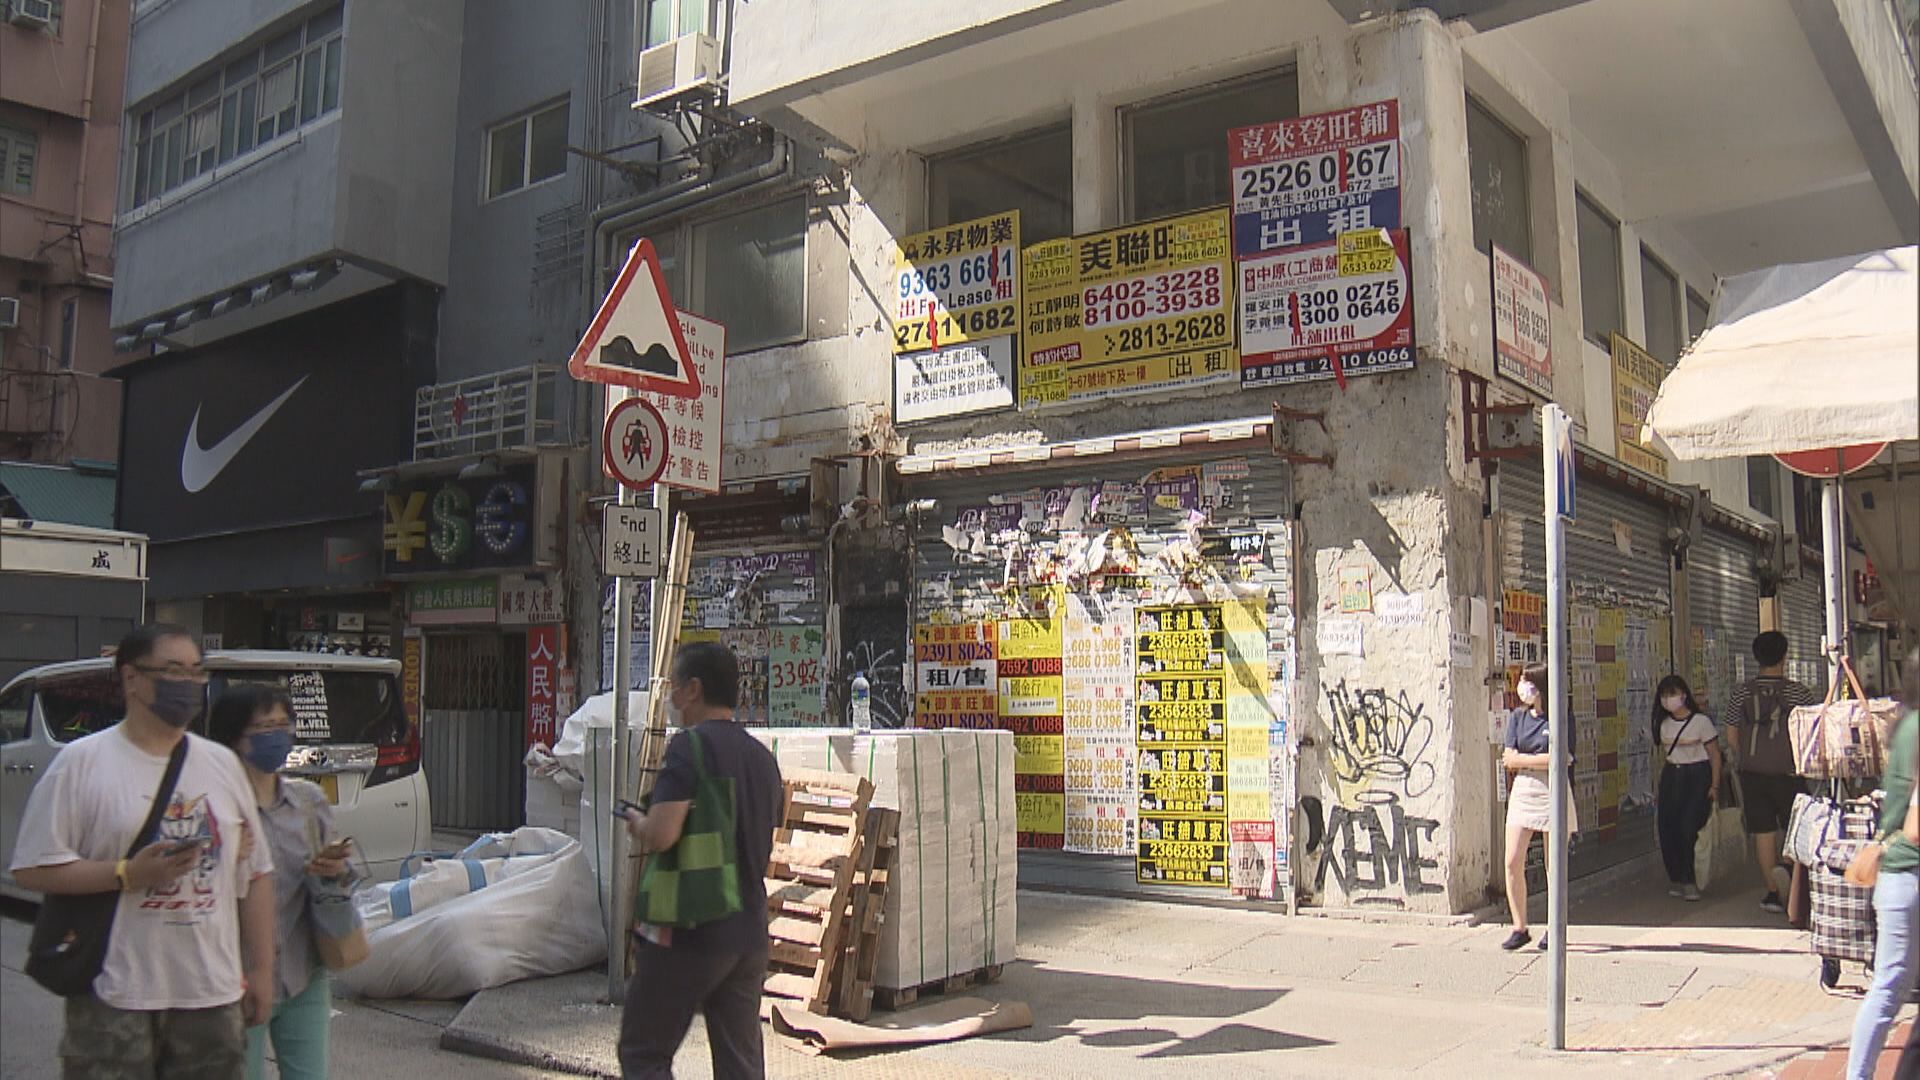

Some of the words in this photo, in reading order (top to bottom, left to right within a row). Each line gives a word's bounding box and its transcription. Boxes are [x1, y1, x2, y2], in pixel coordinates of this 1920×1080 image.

[1241, 160, 1311, 198] 2526
[1345, 178, 1372, 193] 672
[1260, 219, 1302, 250] 出
[1327, 205, 1374, 235] 租
[922, 217, 1012, 258] 永昇物業
[900, 263, 951, 298] 9363
[1084, 267, 1219, 306] 6402-3228
[948, 289, 993, 309] Lease
[1346, 279, 1399, 302] 0275
[1085, 287, 1220, 326] 8100-3938
[1347, 298, 1400, 320] 0646
[679, 322, 696, 336] cle
[1119, 313, 1226, 352] 2813-2628
[686, 342, 699, 357] ill
[702, 344, 715, 360] be
[1367, 347, 1409, 364] 6066
[702, 381, 719, 398] ing
[640, 394, 704, 422] 車等候
[620, 515, 647, 532] End
[91, 551, 111, 571] 成
[613, 541, 652, 565] 終止
[1149, 633, 1212, 650] 23662833
[922, 643, 953, 663] 2391
[958, 641, 993, 661] 8028
[1508, 641, 1538, 661] 租/售
[1000, 661, 1028, 675] 2692
[1031, 658, 1061, 674] 0088
[926, 667, 987, 687] 租/售
[530, 632, 554, 750] 人民幣
[1066, 699, 1092, 713] 9609
[1096, 698, 1122, 713] 9966
[1149, 704, 1213, 719] 23662833
[1033, 716, 1062, 732] 0088
[1096, 714, 1122, 729] 0396
[1067, 759, 1093, 773] 9609
[1016, 776, 1029, 790] 92
[1033, 775, 1063, 790] 0088
[1067, 817, 1094, 832] 9609
[1096, 819, 1123, 833] 9966
[1033, 833, 1063, 848] 0088
[1067, 833, 1093, 847] 3686
[1096, 833, 1123, 848] 0396
[1150, 843, 1214, 860] 23662833
